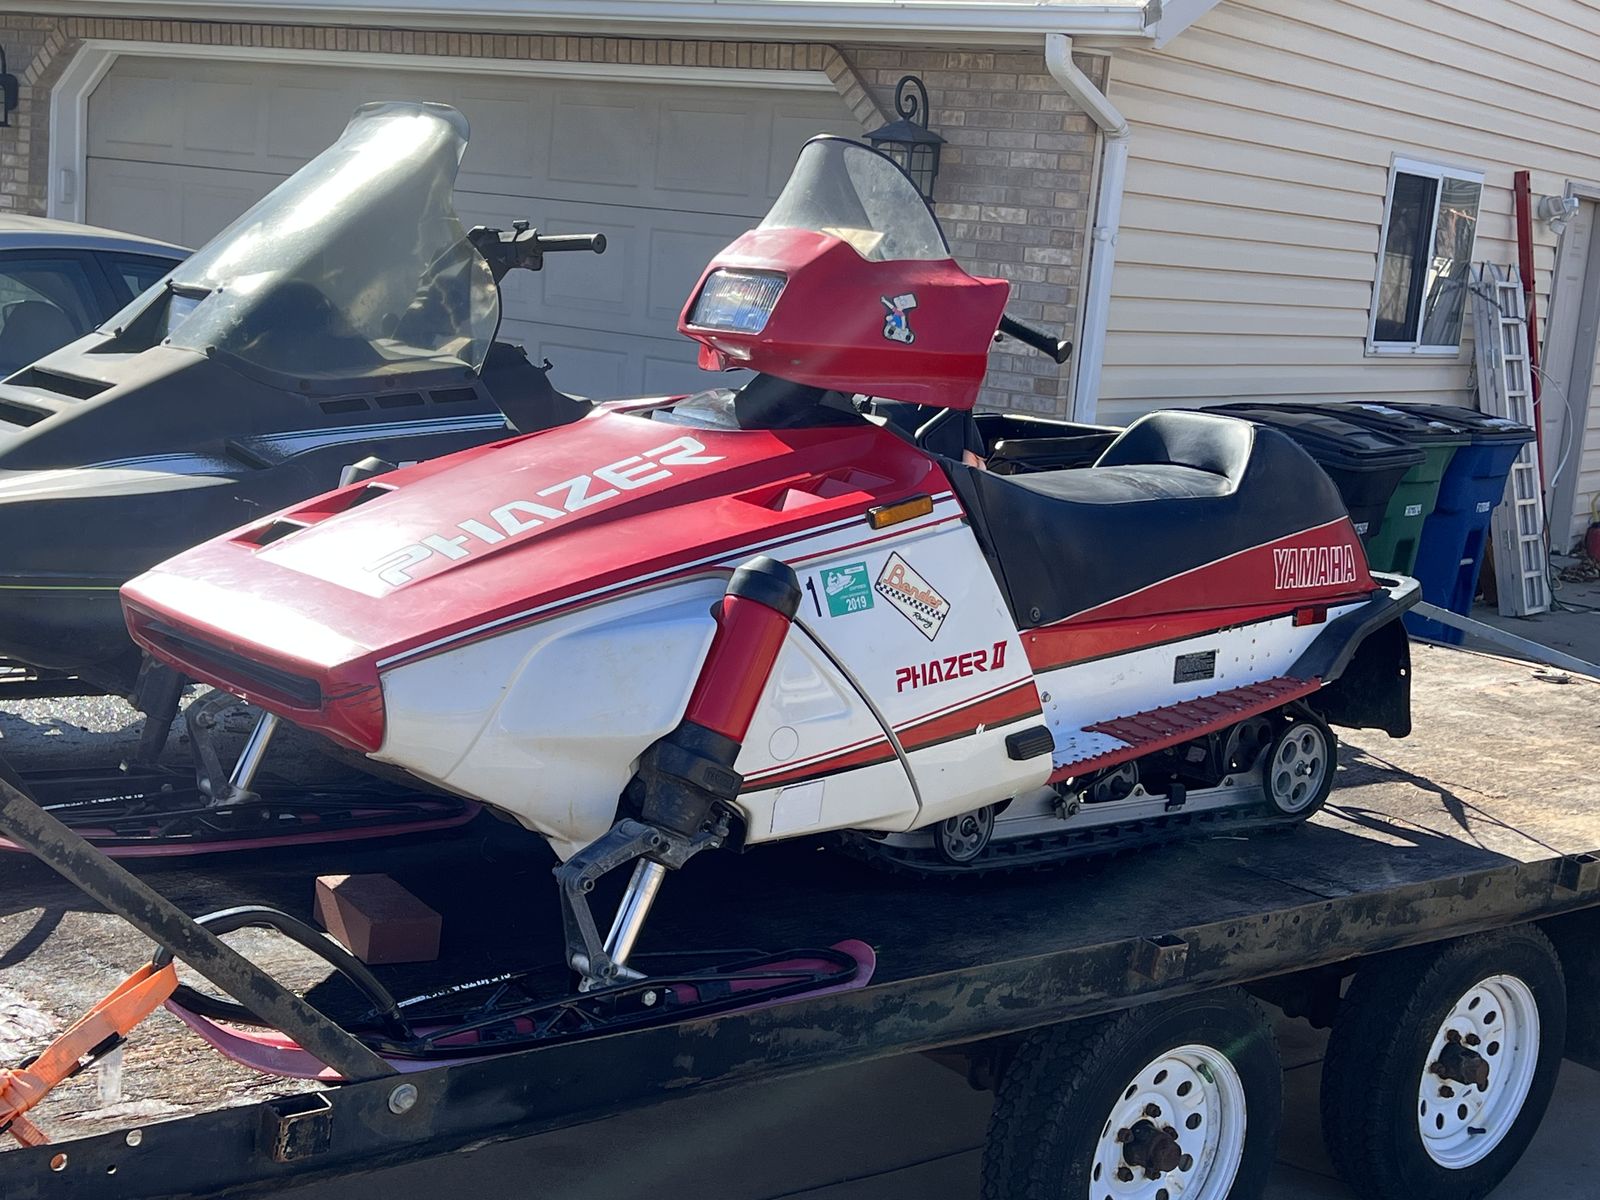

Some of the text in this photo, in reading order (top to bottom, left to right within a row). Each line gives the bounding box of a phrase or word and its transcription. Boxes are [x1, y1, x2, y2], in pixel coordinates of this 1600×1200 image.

[362, 436, 727, 587] PHAZER
[883, 563, 943, 608] Bender
[1273, 544, 1356, 590] YAMAHA
[846, 596, 867, 611] 2019
[912, 611, 933, 629] Racing
[895, 650, 988, 692] PHAZER
